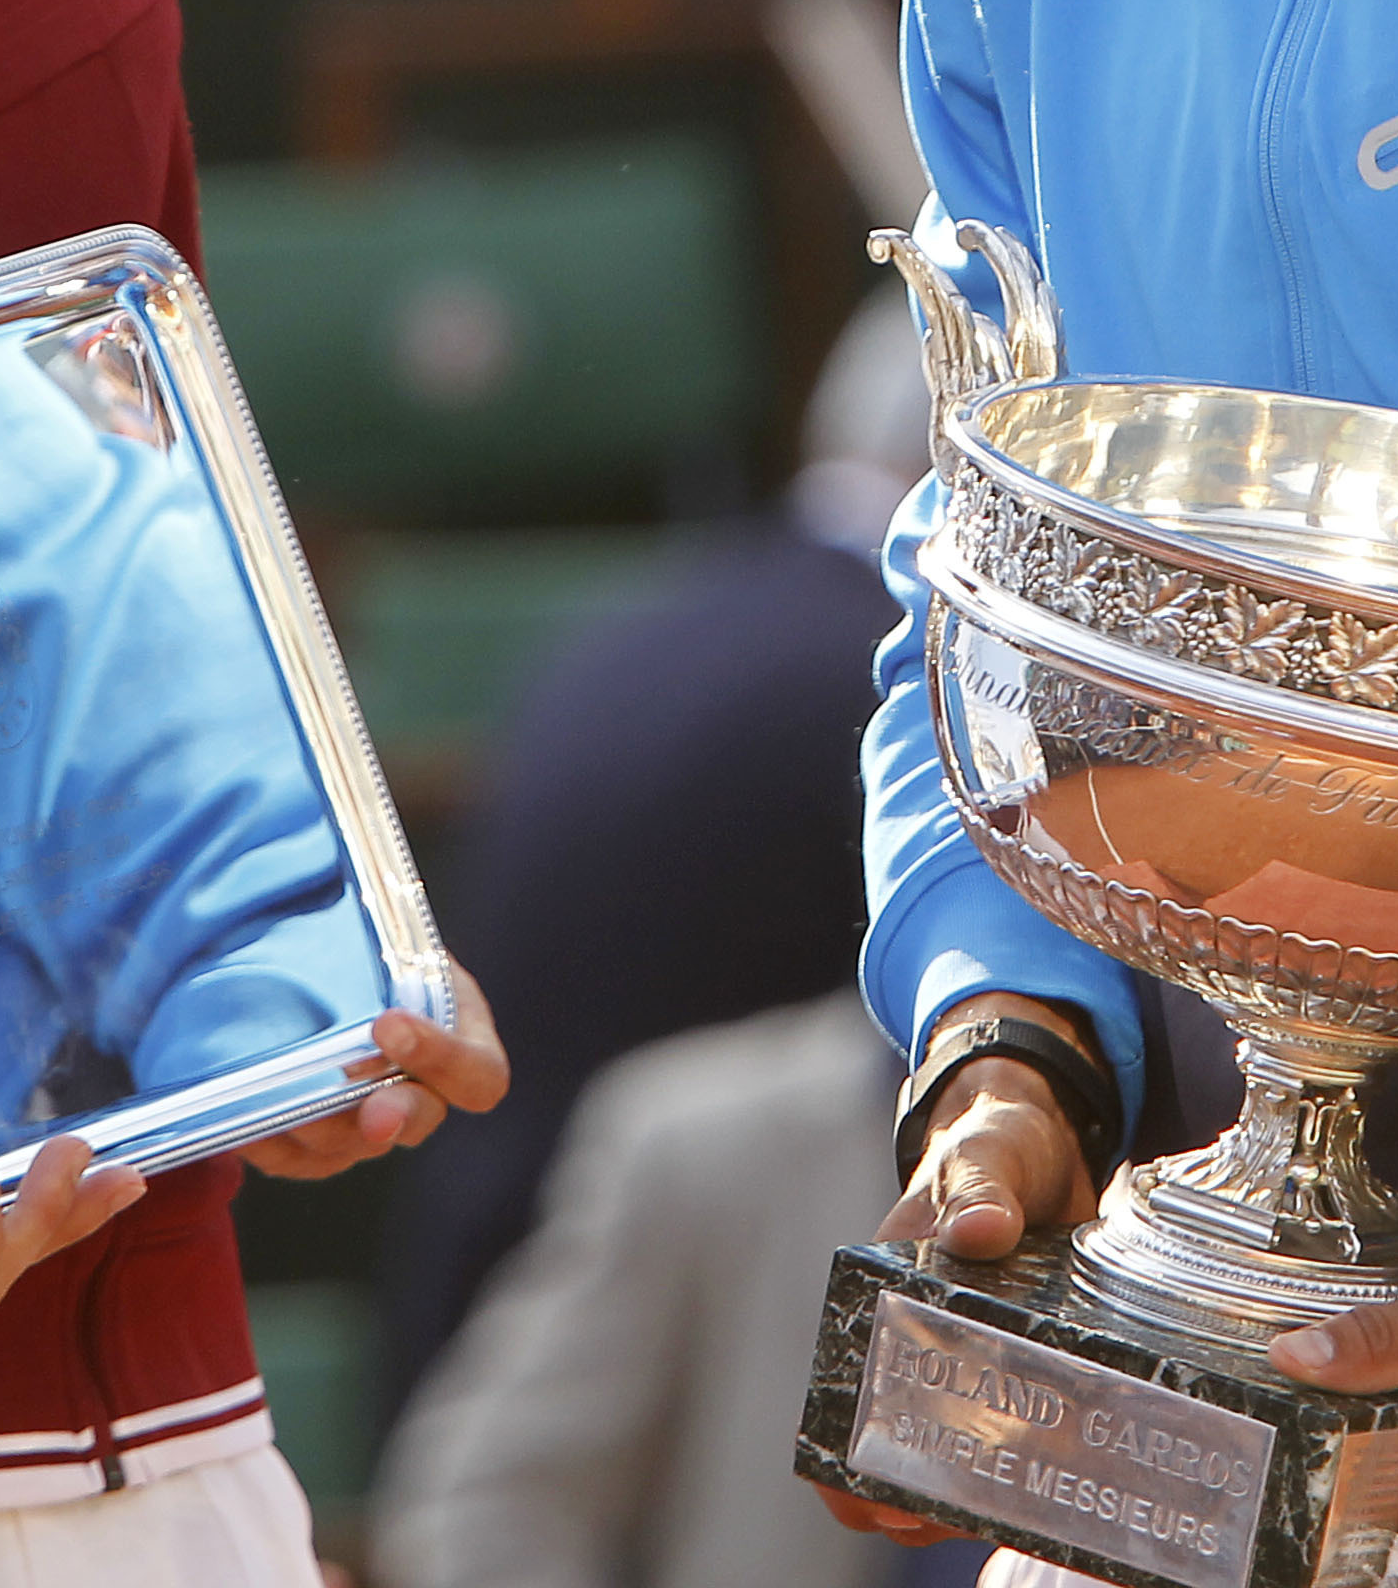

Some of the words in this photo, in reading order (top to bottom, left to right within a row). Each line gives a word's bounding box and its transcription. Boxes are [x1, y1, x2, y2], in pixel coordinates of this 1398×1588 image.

[1219, 751, 1291, 802] de
[889, 1338, 1064, 1429] ROLAND
[1082, 1410, 1253, 1497] GARROS
[891, 1412, 1018, 1486] SIMPLE
[1024, 1458, 1221, 1557] MESSIEURS
